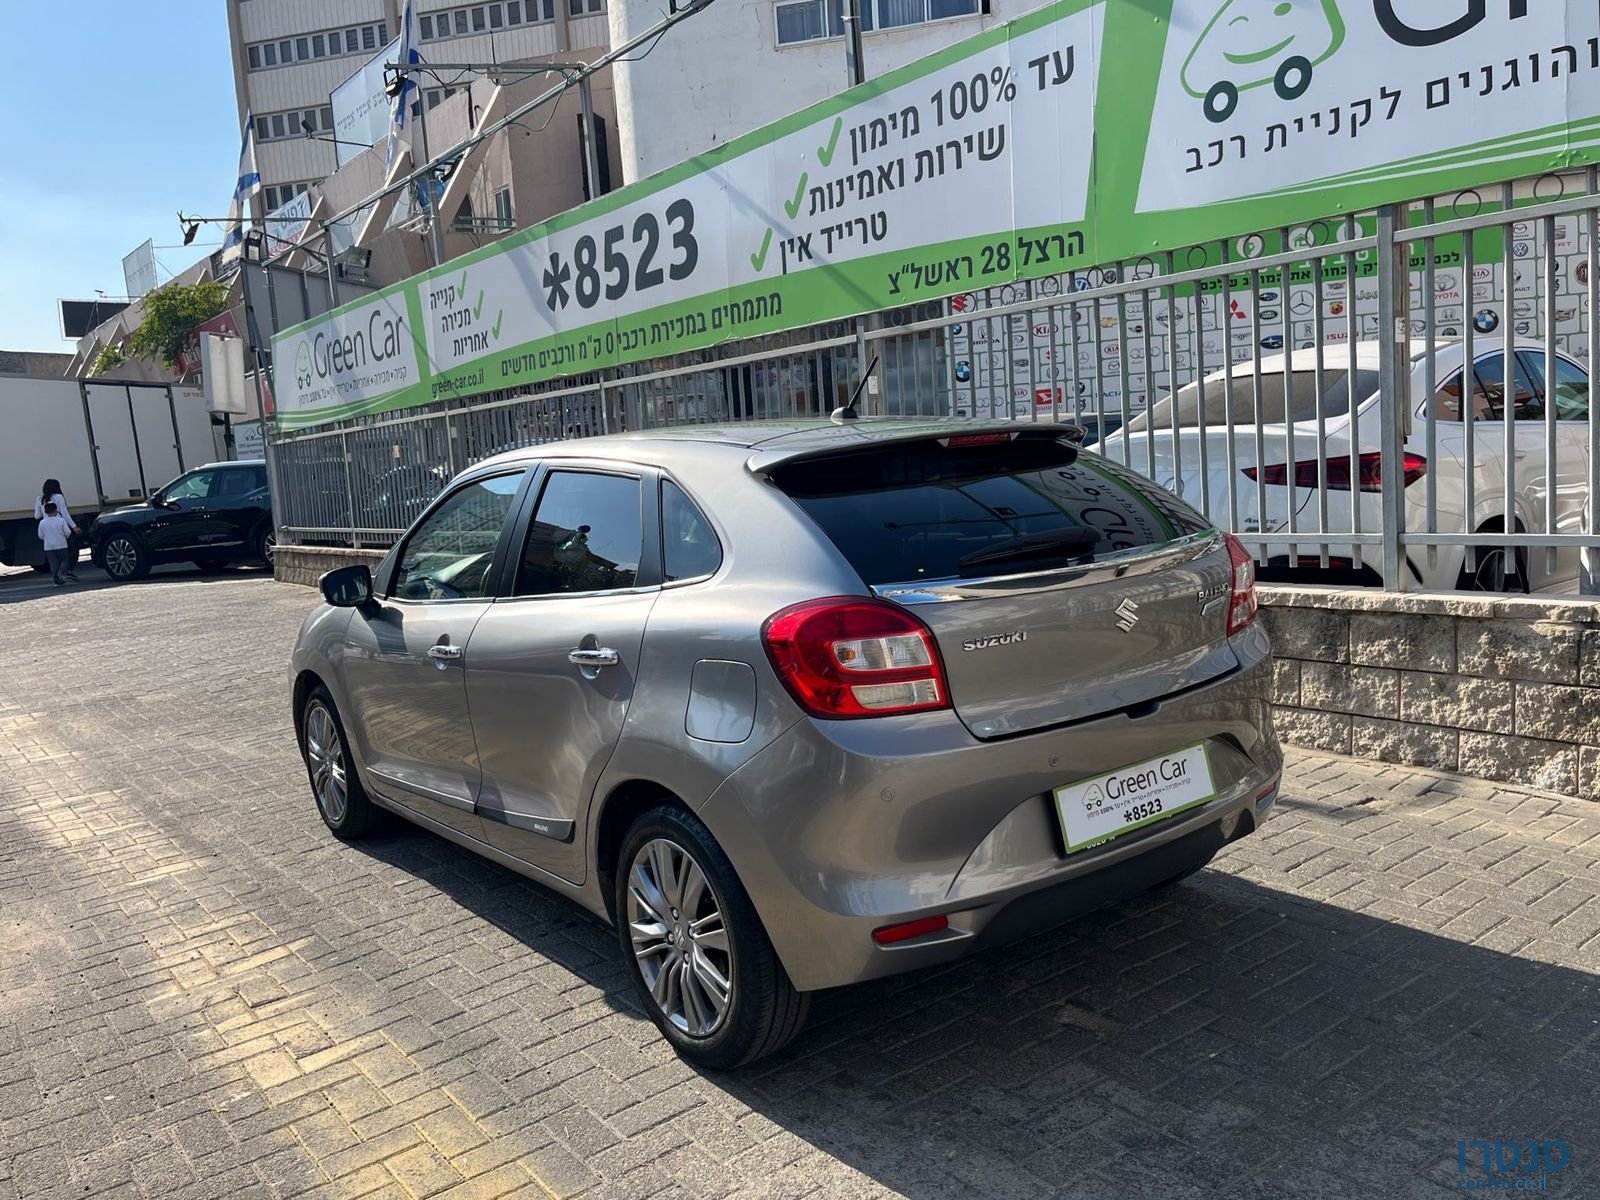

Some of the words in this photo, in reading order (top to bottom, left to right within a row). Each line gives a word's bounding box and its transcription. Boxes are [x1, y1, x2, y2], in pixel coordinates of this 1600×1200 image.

[1028, 45, 1075, 92] עד
[1426, 37, 1599, 110] והוגנים
[930, 66, 1017, 127] 100%
[849, 105, 921, 167] מימון
[1265, 86, 1401, 153] לקניית
[914, 124, 1005, 183] שירות
[1186, 134, 1246, 173] רכב
[808, 157, 905, 217] ואמינות
[820, 210, 887, 256] טרייד
[1017, 230, 1085, 266] הרצל
[779, 232, 813, 276] אין
[980, 241, 1011, 275] 28
[888, 255, 974, 296] ראשל"צ
[430, 285, 456, 310] קנייה
[712, 292, 783, 330] מתמחים
[1434, 291, 1460, 300] OYOTA
[442, 308, 471, 333] מכירה
[617, 327, 647, 351] רכבי
[650, 311, 706, 349] במכירת
[314, 331, 365, 378] Green
[369, 309, 403, 362] Car
[453, 331, 489, 357] אחריות
[539, 343, 576, 369] ורכבים
[578, 334, 602, 360] ק"מ
[605, 332, 614, 354] 0
[431, 370, 485, 398] green-car.co.il
[501, 353, 536, 378] חדשים
[962, 631, 1028, 652] SUZUKI
[1106, 769, 1158, 800] Green
[1160, 758, 1187, 781] Car
